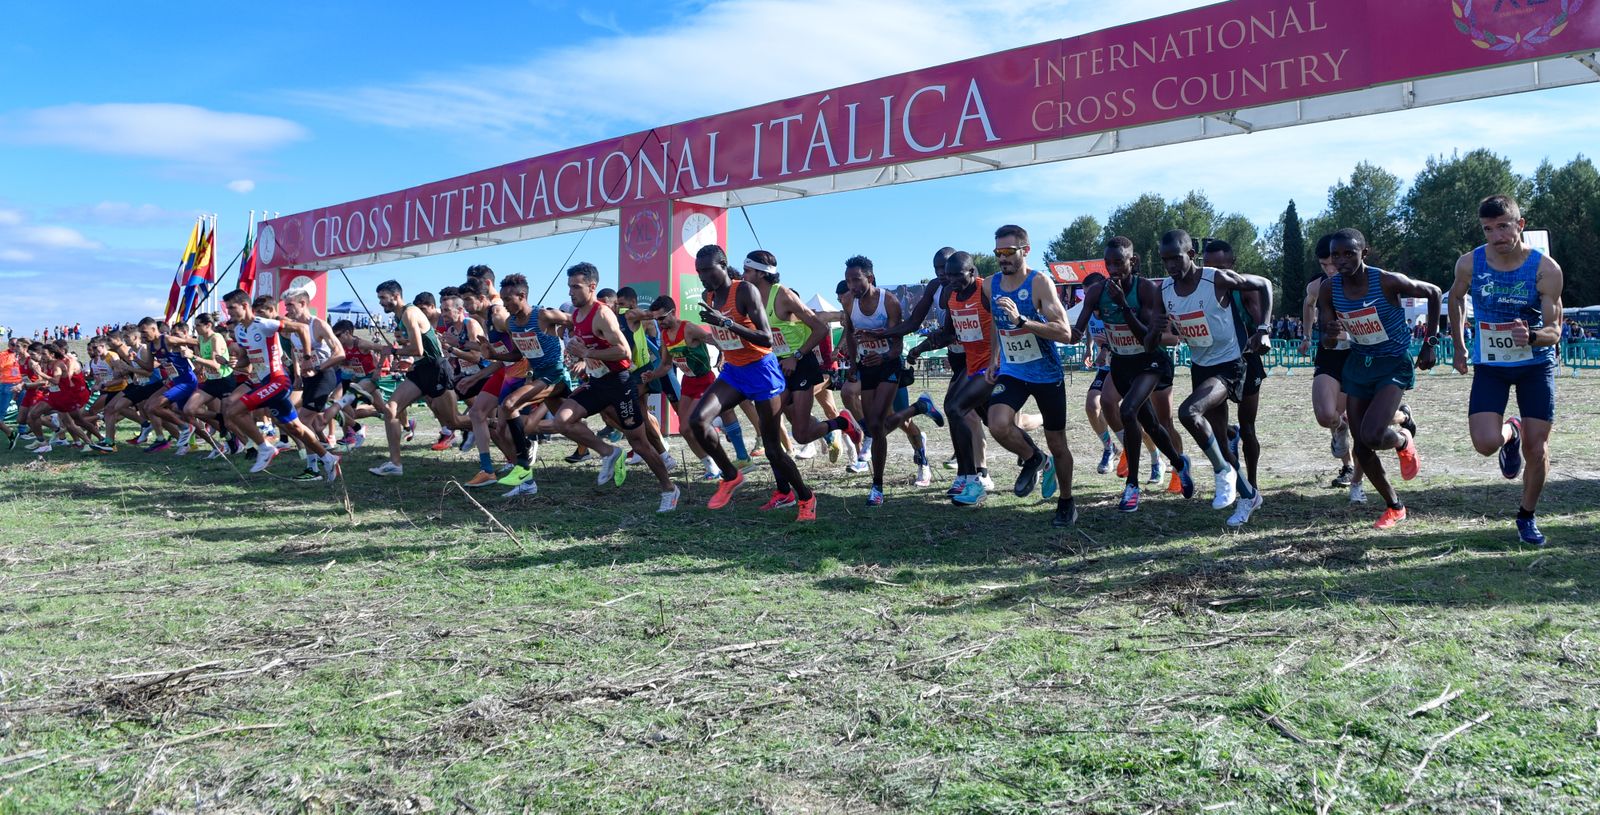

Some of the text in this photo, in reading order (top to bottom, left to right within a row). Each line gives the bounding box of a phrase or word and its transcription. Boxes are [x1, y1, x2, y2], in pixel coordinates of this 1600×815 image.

[1033, 2, 1328, 89] INTERNATIONAL
[1032, 47, 1350, 133] CROSS COUNTRY
[312, 77, 1002, 258] CROSS INTERNACIONAL ITÁLICA
[1006, 339, 1032, 352] 1614
[1488, 336, 1513, 349] 160
